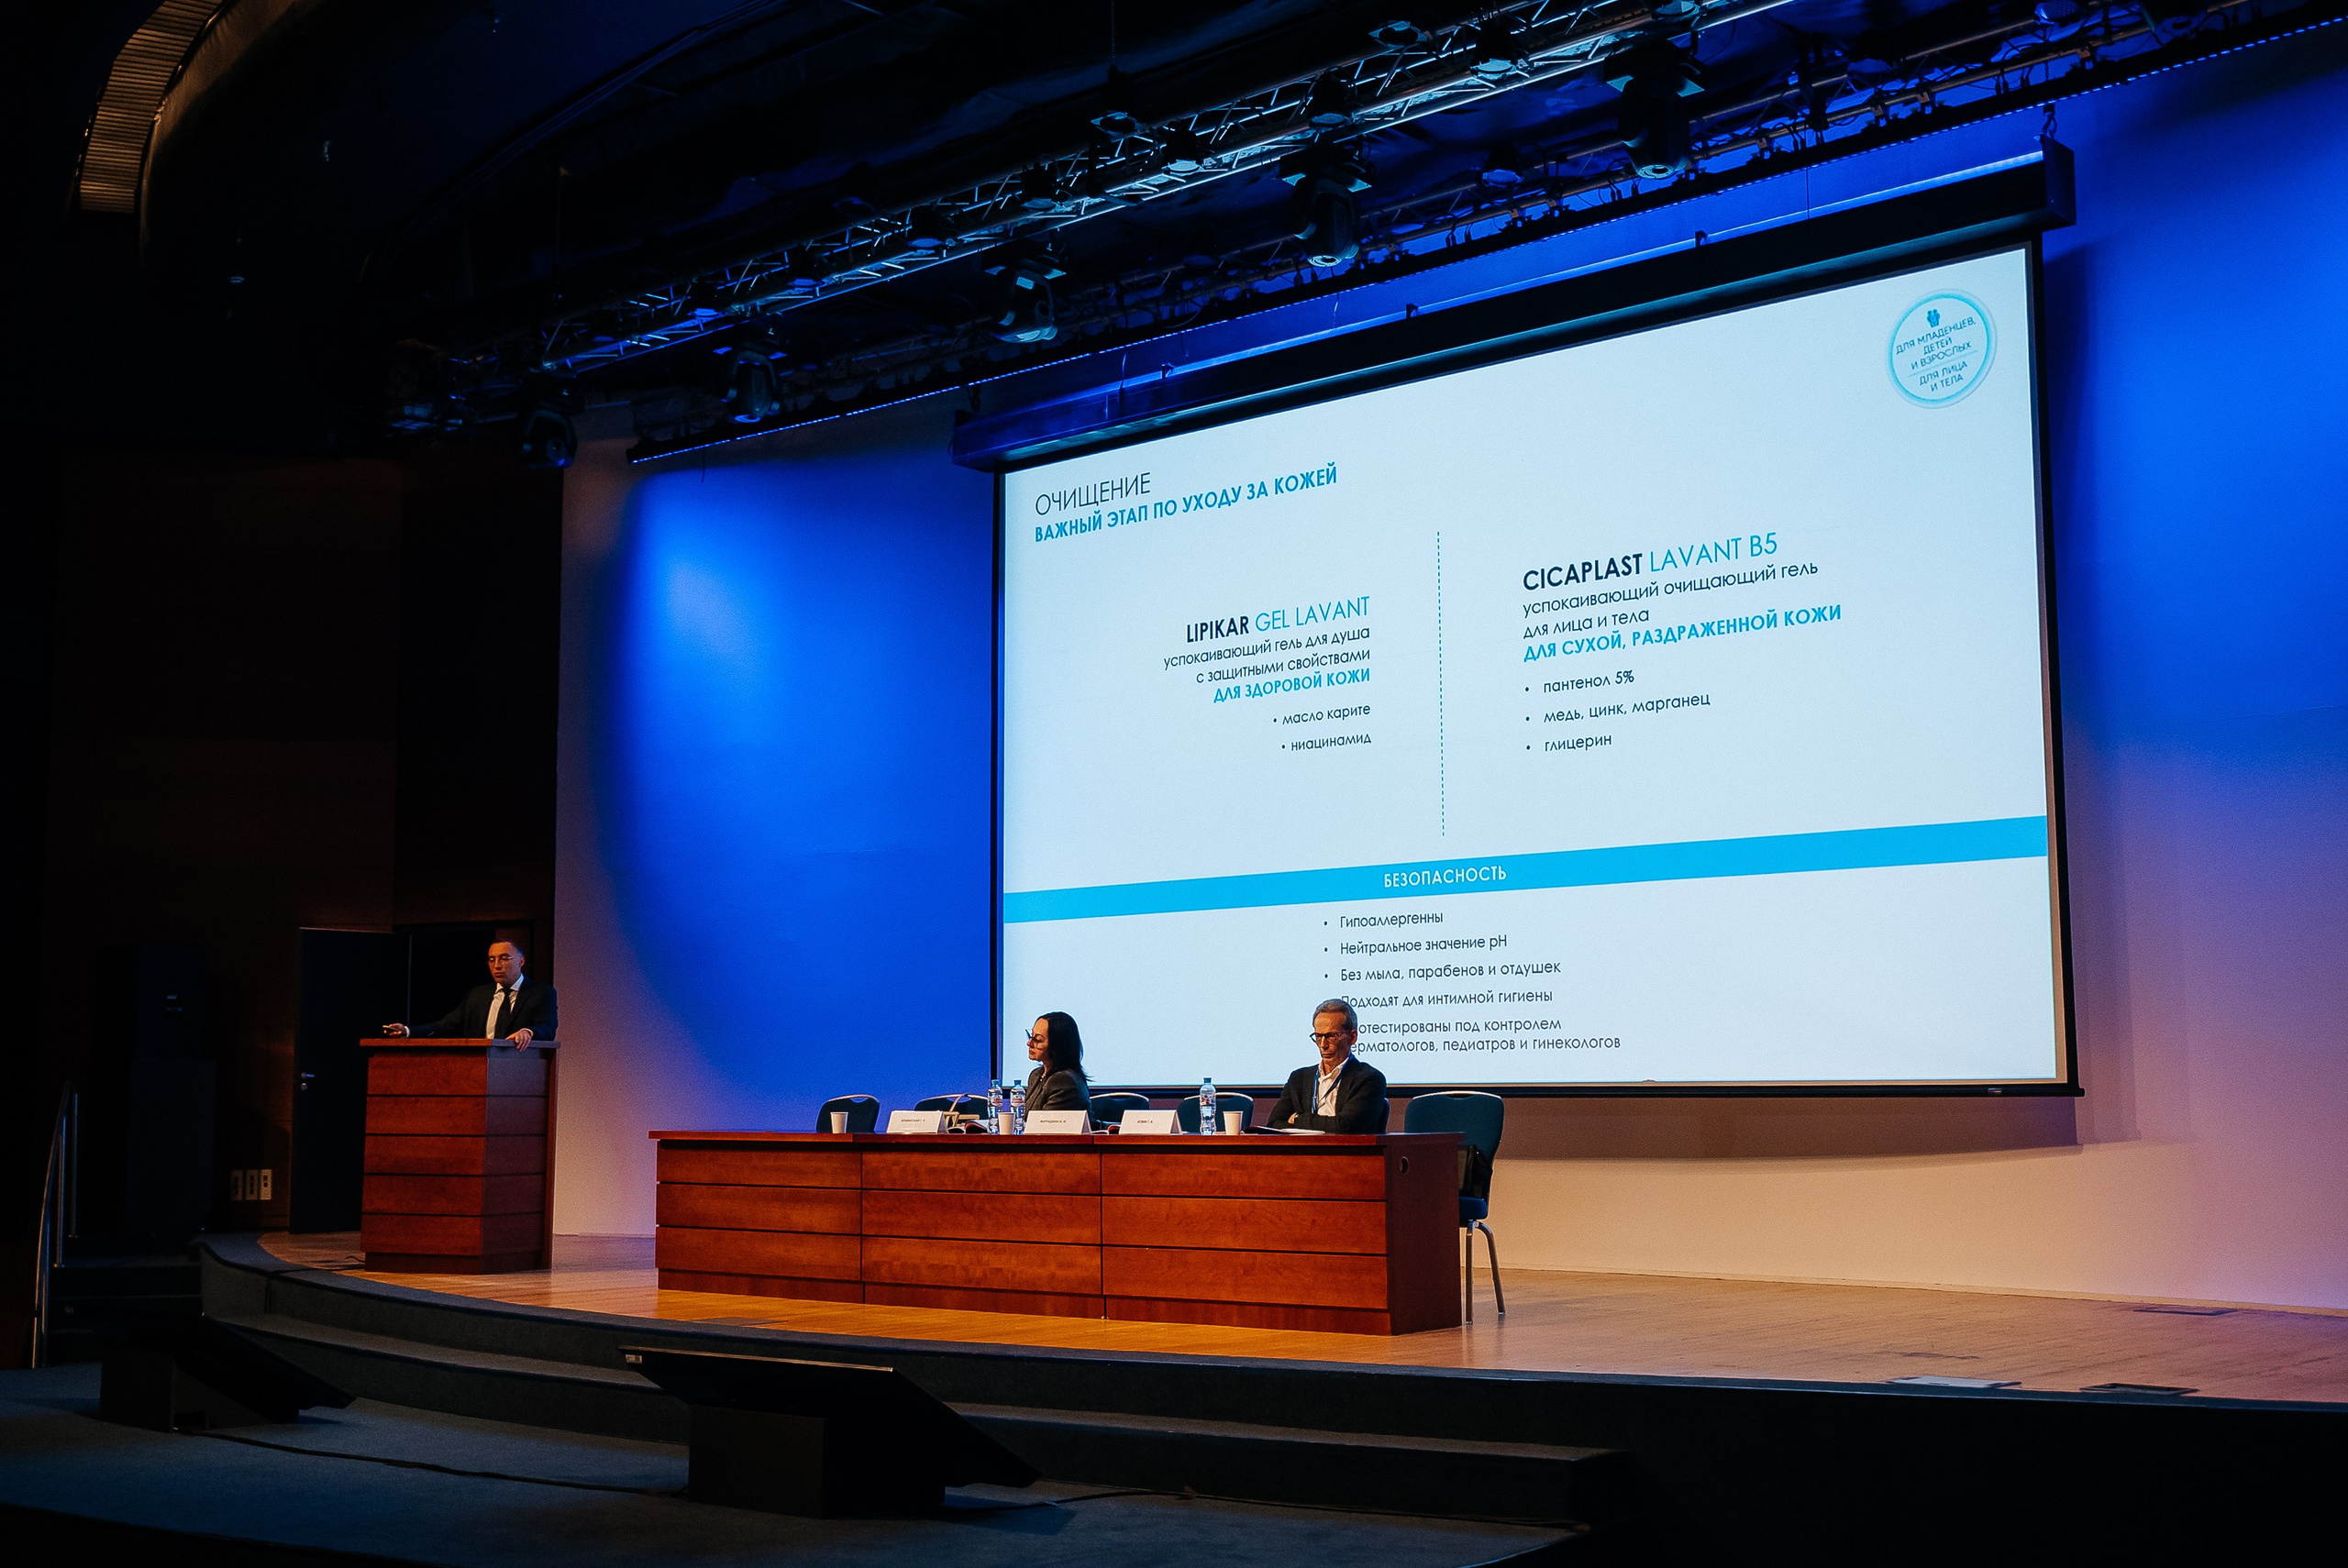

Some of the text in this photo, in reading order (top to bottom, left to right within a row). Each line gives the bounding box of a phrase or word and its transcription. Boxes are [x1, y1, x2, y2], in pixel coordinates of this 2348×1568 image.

[1896, 316, 1976, 355] ДЛЯ МЛАДЕНЦЕВ,
[1923, 336, 1953, 355] ДЕТЕЙ
[1911, 341, 1971, 370] И ВЗРОСЛЫХ
[1920, 361, 1967, 386] ДЛЯ ЛИЦА
[1931, 374, 1964, 392] И ТЕЛА
[1035, 472, 1151, 515] ОЧИЩЕНИЕ
[1035, 462, 1337, 542] ВАЖНЫЙ ЭТАП ПО УХОДУ ЗА КОЖЕЙ
[1523, 532, 1778, 591] CICAPLAST LAVANT B5
[1523, 563, 1818, 618] успокаивающий очищающий гель
[1187, 596, 1370, 644] LIPIKAR GEL LAVANT
[1523, 608, 1649, 639] для лица и тела
[1523, 604, 1842, 662] ДЛЯ СУХОЙ, РАЗДРАЖЕННОЙ КОЖИ
[1164, 626, 1370, 670] успокаивающий гель для душа
[1196, 648, 1370, 684] с защитными свойствами
[1213, 668, 1370, 703] ДЛЯ ЗДОРОВОЙ КОЖИ
[1543, 669, 1634, 693] пантенол 5%
[1282, 703, 1371, 725] масло карите
[1544, 693, 1711, 723] медь, цинк, марганец
[1290, 733, 1372, 751] ниацинамид
[1545, 734, 1612, 752] глицерин
[1384, 866, 1507, 888] БЕЗОПАСНОСТЬ
[1340, 912, 1444, 929] Гипоаллергенны
[1340, 940, 1422, 955] Нейтральное
[1425, 937, 1486, 951] значение
[1341, 961, 1561, 981] Без мыла, парабенов и отдушек
[1403, 996, 1423, 1007] для
[1428, 990, 1494, 1006] интимной
[1499, 989, 1553, 1004] гигиены
[1358, 1019, 1562, 1036] отестированы под контролем
[1352, 1036, 1621, 1055] ерматологов, педиатров и гинекологов
